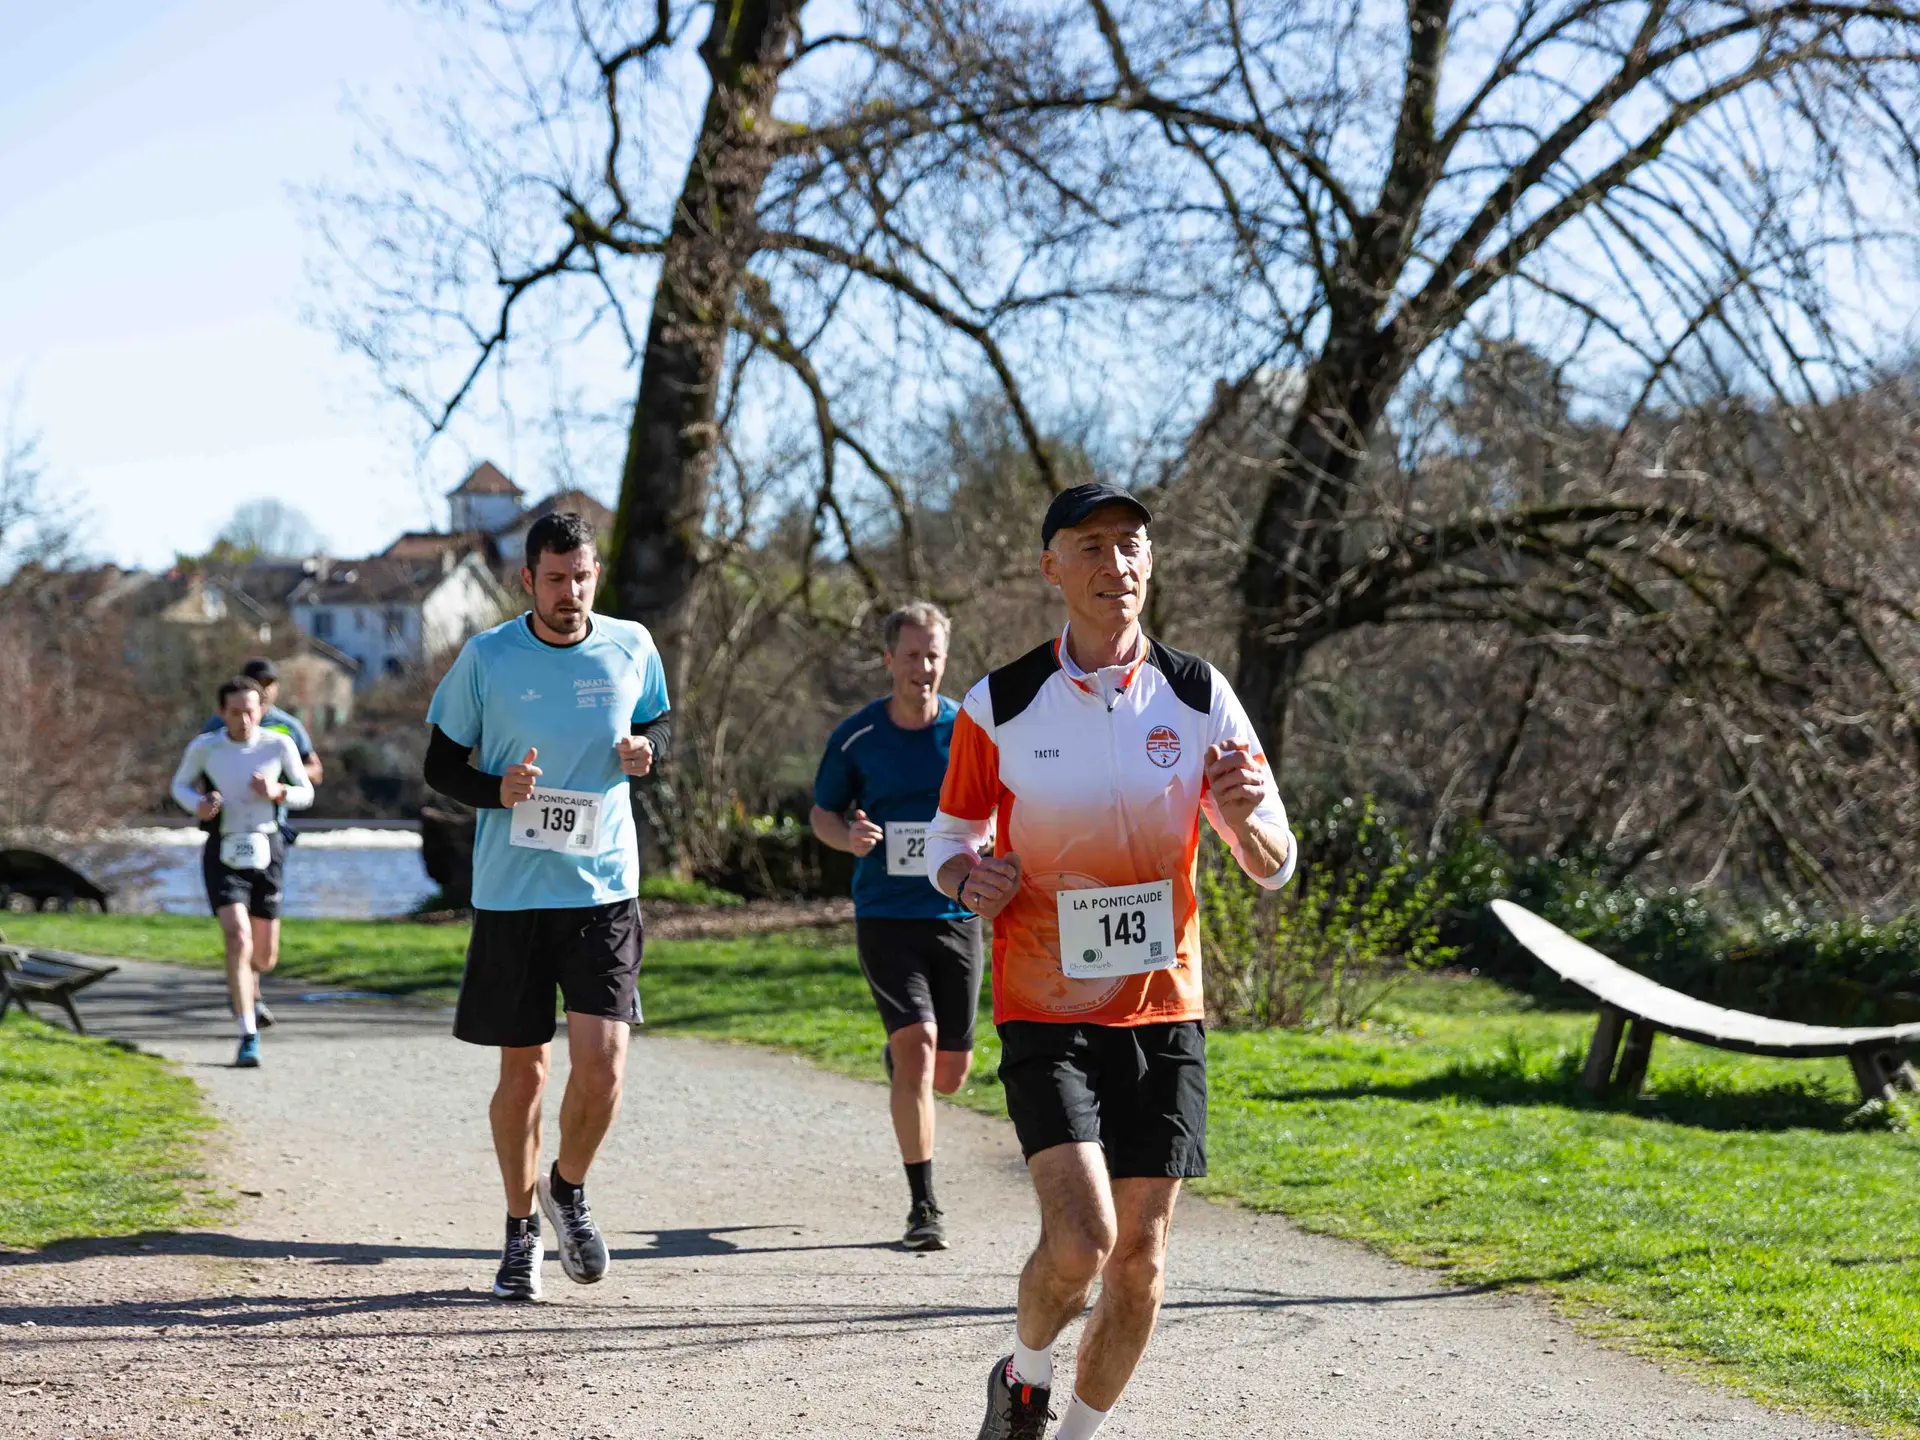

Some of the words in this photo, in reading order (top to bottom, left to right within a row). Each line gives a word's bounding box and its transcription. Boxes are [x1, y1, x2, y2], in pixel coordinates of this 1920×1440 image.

[1034, 749, 1060, 759] TACTIC
[1145, 741, 1181, 751] CRC
[538, 794, 594, 808] PONTICAUDE
[541, 806, 576, 833] 139
[1073, 899, 1088, 911] LA
[1091, 890, 1162, 909] PONTICAUDE
[1098, 910, 1147, 948] 143
